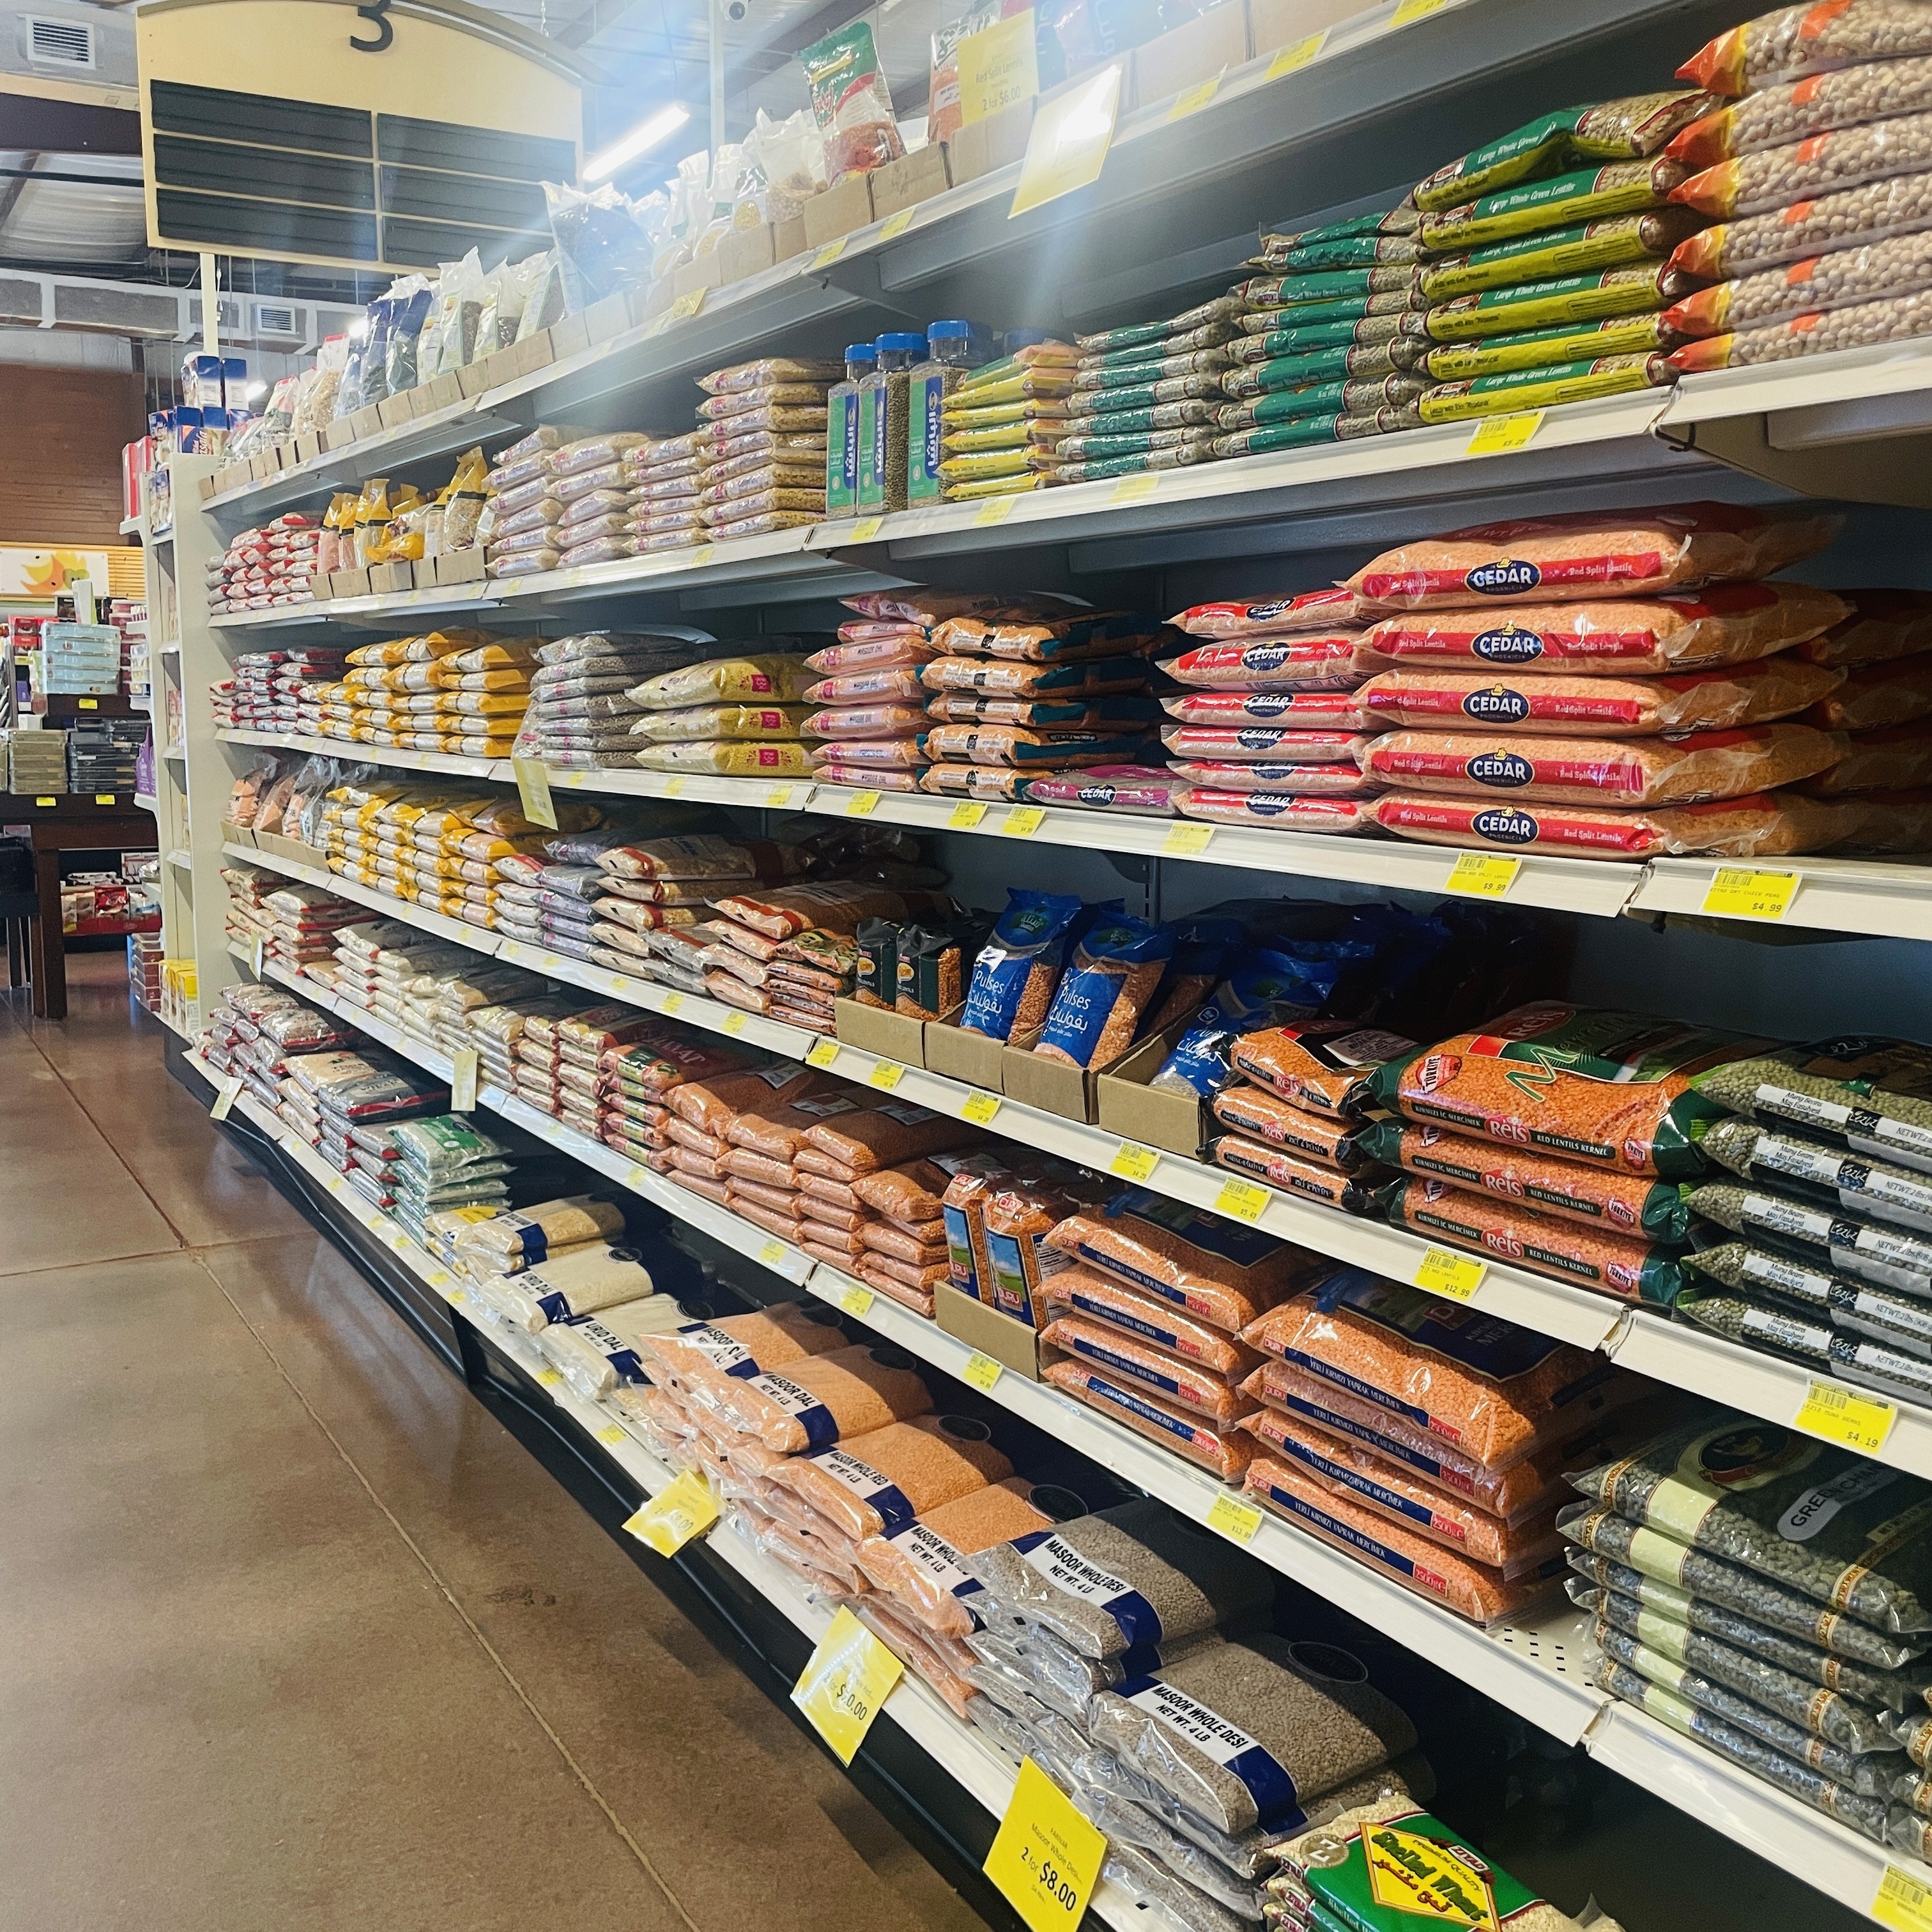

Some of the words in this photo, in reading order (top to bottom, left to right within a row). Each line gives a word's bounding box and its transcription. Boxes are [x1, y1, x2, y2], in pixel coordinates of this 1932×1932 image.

[350, 2, 394, 52] 3
[983, 99, 988, 112] 2
[999, 86, 1021, 107] $6.00
[1489, 199, 1508, 213] Large
[1510, 193, 1529, 206] Whole
[1494, 290, 1514, 300] Large
[1485, 377, 1505, 387] Large
[1475, 567, 1533, 588] CEDAR
[1570, 567, 1584, 576] Red
[1586, 565, 1605, 575] Split
[1409, 640, 1423, 649] Split
[1479, 636, 1535, 655] CEDAR
[1246, 647, 1285, 663] CEDAR
[1250, 695, 1289, 708] CEDAR
[1469, 695, 1522, 716] CEDAR
[1473, 760, 1526, 780] CEDAR
[1080, 787, 1112, 801] CEDAR
[1412, 812, 1426, 822] Split
[1479, 815, 1531, 838] CEDAR
[1564, 829, 1577, 838] Red
[1579, 830, 1595, 839] Split
[1483, 882, 1506, 891] $9.99
[1752, 902, 1782, 912] $4.99
[973, 970, 1004, 994] Pulses
[1059, 988, 1091, 1011] Pulses
[1276, 1075, 1301, 1093] Reis
[1264, 1123, 1285, 1141] Reis
[1490, 1120, 1527, 1143] Reis
[1537, 1134, 1550, 1144] RED
[1552, 1137, 1579, 1150] LENTILS
[1581, 1144, 1608, 1156] KERNEL
[1269, 1165, 1290, 1183] Reis
[1485, 1174, 1522, 1197] Reis
[1530, 1189, 1542, 1199] RED
[1544, 1193, 1569, 1206] LENTILS
[1486, 1233, 1522, 1257] Reis
[1529, 1248, 1542, 1259] RED
[1542, 1252, 1568, 1267] LENTILS
[1568, 1261, 1593, 1276] KERNEL
[1445, 1284, 1470, 1297] $12.99
[602, 1332, 625, 1351] DAL
[1264, 1337, 1284, 1354] DURU
[760, 1384, 772, 1392] NET
[763, 1373, 799, 1396] MASOOR
[793, 1392, 816, 1407] DAL
[1265, 1384, 1286, 1401] DURU
[1262, 1425, 1284, 1443] DURU
[1846, 1430, 1879, 1448] $4.19
[826, 1462, 840, 1471] NET
[849, 1476, 862, 1484] LB
[850, 1459, 875, 1478] WHOLE
[871, 1473, 889, 1486] RED
[1250, 1475, 1271, 1492] DURU
[910, 1526, 942, 1549] MASOOR
[908, 1542, 924, 1554] NET
[921, 1551, 934, 1565] WT.
[933, 1563, 947, 1574] LB
[1044, 1540, 1084, 1570] MASOOR
[1077, 1564, 1110, 1586] WHOLE
[1103, 1576, 1127, 1593] DESI
[1049, 1565, 1067, 1579] NET
[1062, 1575, 1078, 1587] WT.
[1151, 1686, 1194, 1714] MASOOR
[1188, 1706, 1225, 1733] WHOLE
[1217, 1726, 1249, 1750] DESI
[1154, 1703, 1174, 1719] NET
[1169, 1713, 1188, 1728] WT.
[1188, 1726, 1197, 1735] 4
[1193, 1729, 1211, 1743] LB
[1412, 1839, 1452, 1866] PREMIUM
[1450, 1862, 1482, 1893] QUALITY
[1453, 1846, 1487, 1870] ZIYAD
[1021, 1846, 1029, 1862] 2
[1028, 1856, 1039, 1873] for
[1039, 1860, 1077, 1912] $8.00
[1370, 1831, 1438, 1880] Shelled
[1429, 1874, 1489, 1922] Wheat
